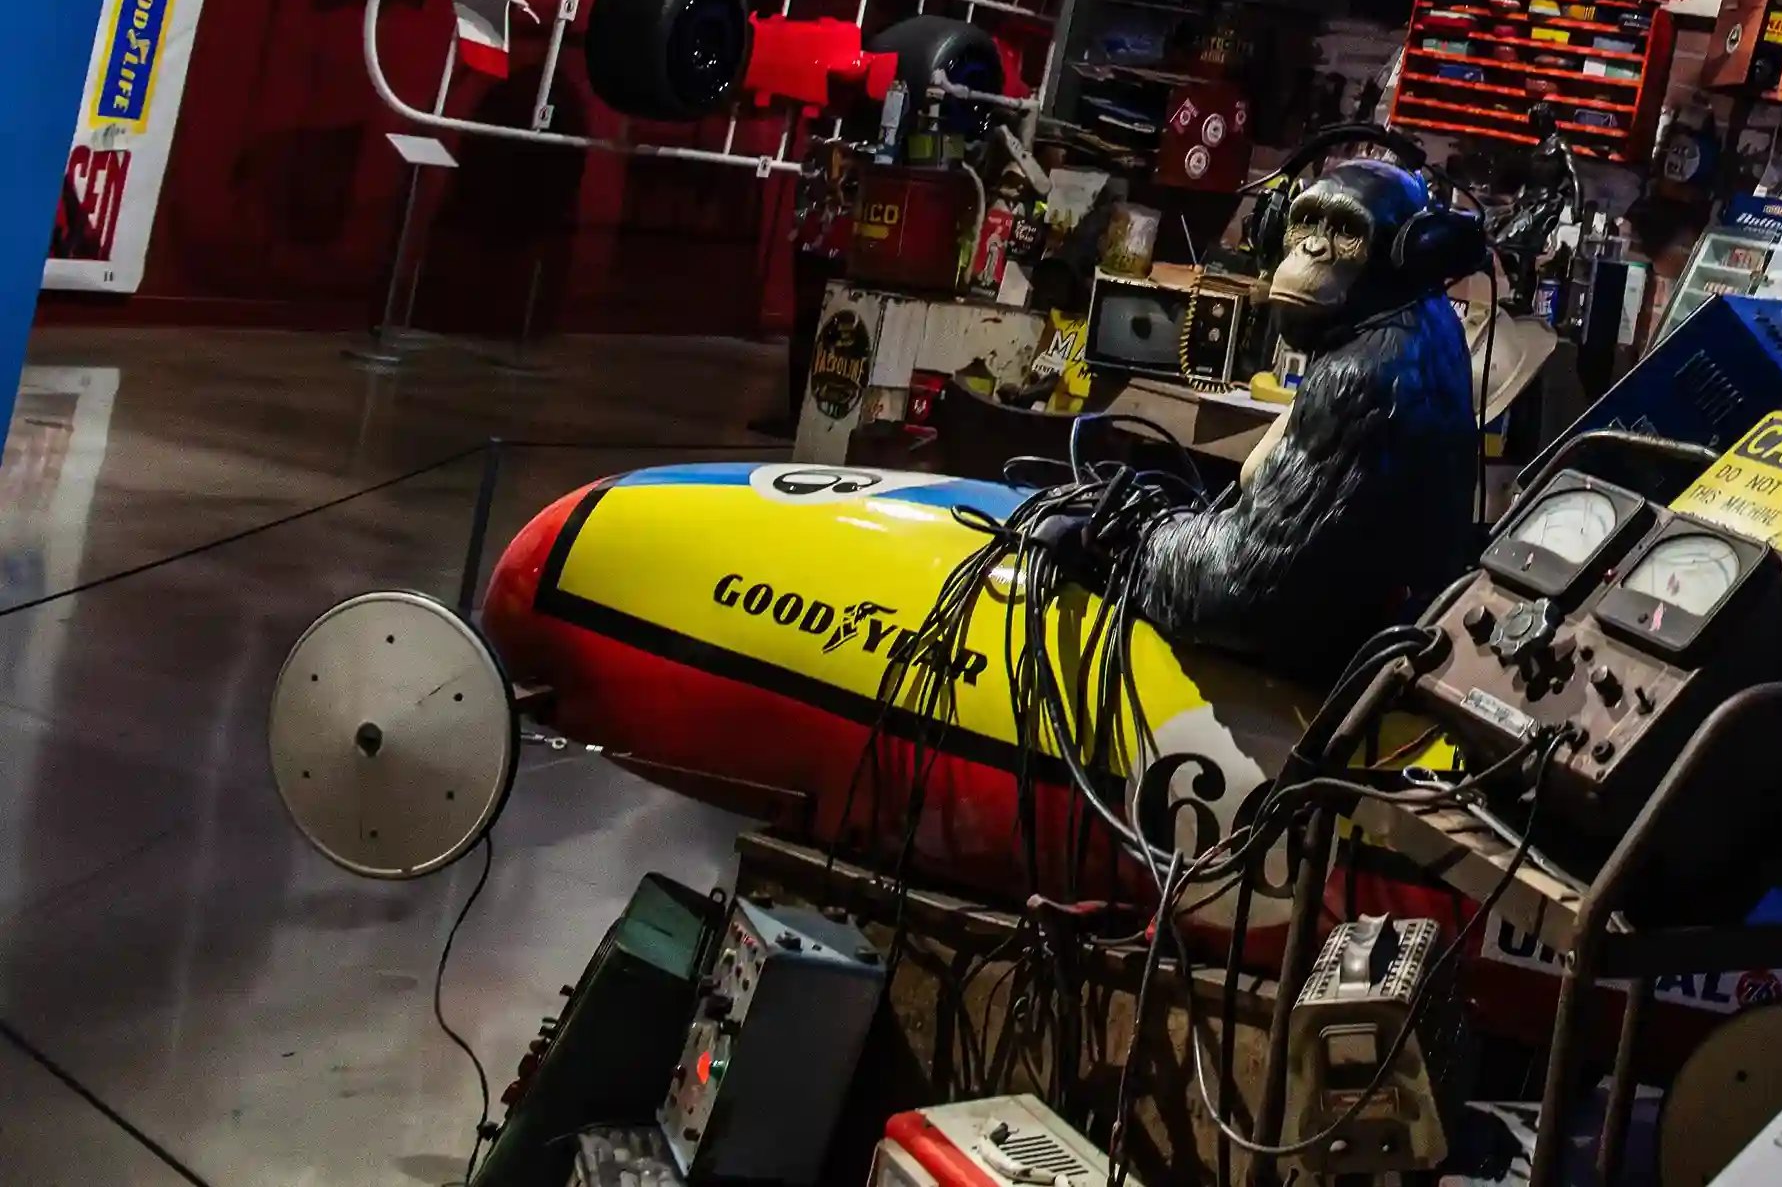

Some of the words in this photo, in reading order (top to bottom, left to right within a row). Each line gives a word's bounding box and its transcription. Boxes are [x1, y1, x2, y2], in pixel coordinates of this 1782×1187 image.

[1715, 464, 1743, 481] DO
[1688, 484, 1722, 502] THIS
[712, 573, 988, 686] GOODYEAR
